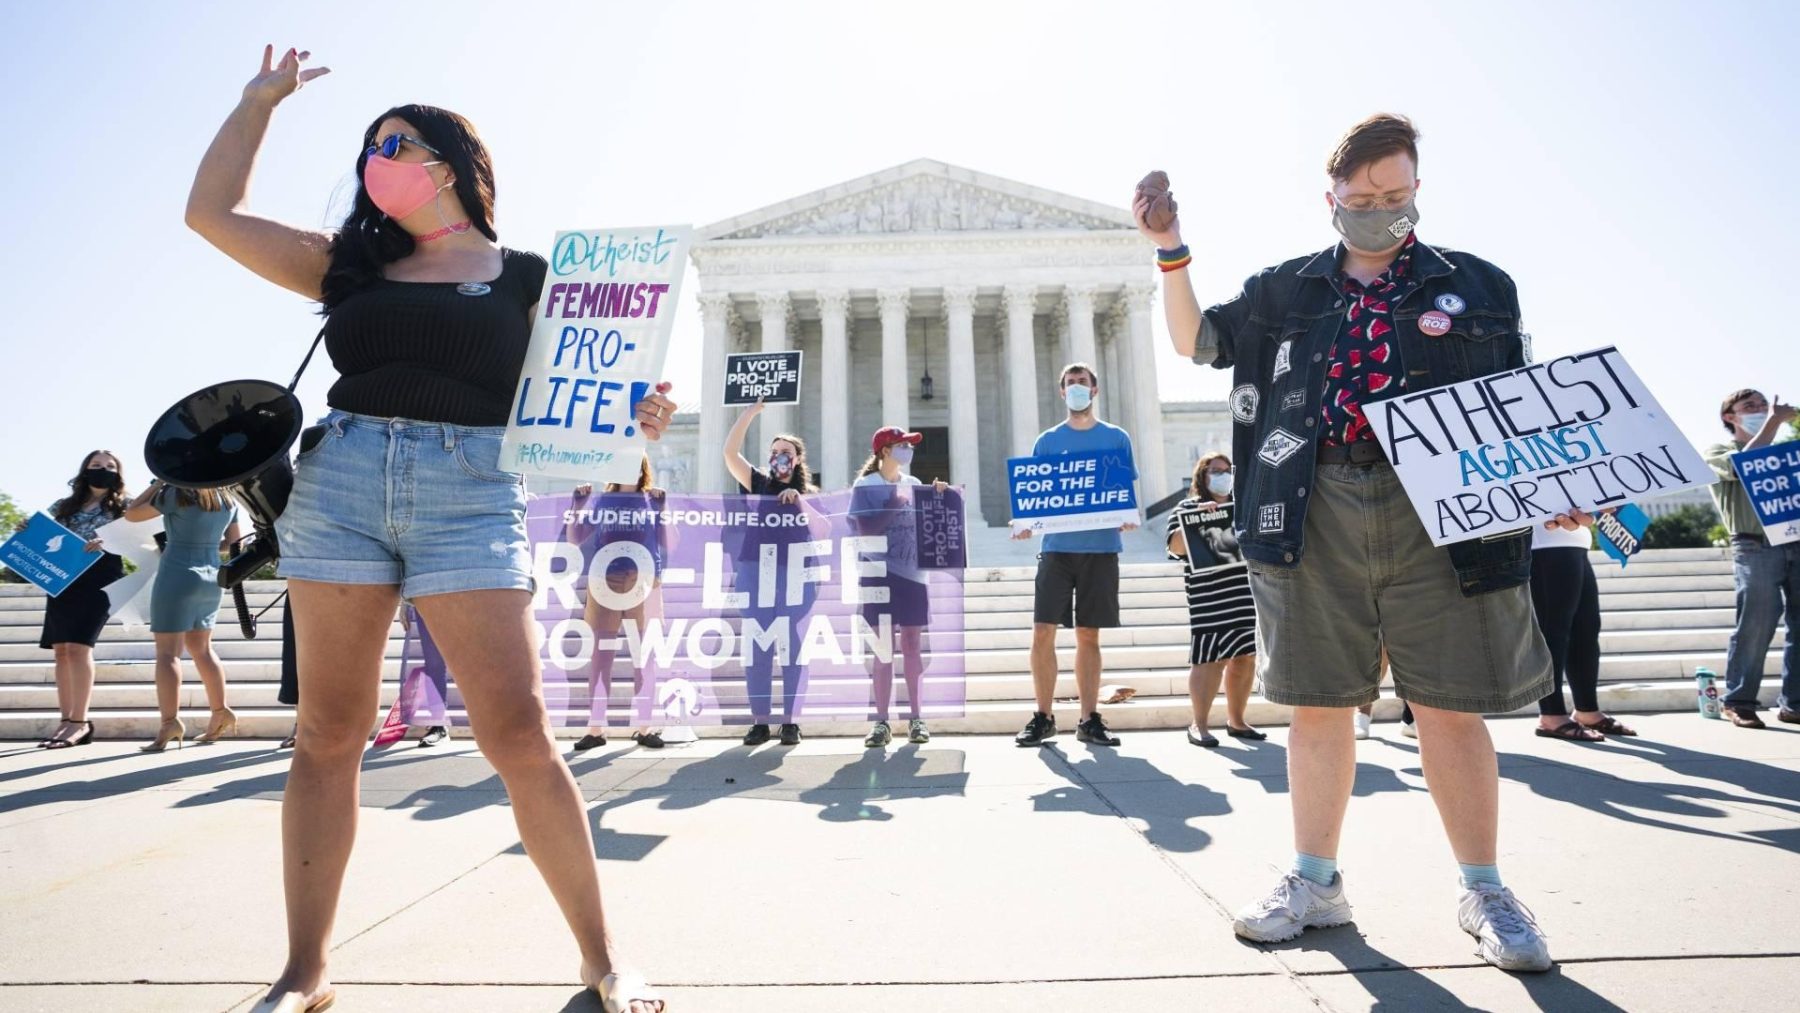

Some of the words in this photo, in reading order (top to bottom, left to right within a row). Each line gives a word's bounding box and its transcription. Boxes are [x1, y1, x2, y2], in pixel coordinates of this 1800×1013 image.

[545, 282, 670, 319] FEMINIST
[1421, 319, 1449, 330] ROE
[553, 325, 636, 374] PRO-
[727, 370, 797, 385] PRO-LIFE
[736, 361, 742, 373] I
[747, 359, 788, 372] VOTE
[740, 383, 780, 397] FIRST
[516, 377, 650, 437] LIFE!
[1384, 345, 1641, 466] ATHEIST
[515, 443, 614, 471] #Rehumanize
[1457, 420, 1611, 487] AGAINST
[1013, 459, 1097, 478] PRO-LIFE
[1015, 479, 1054, 494] FOR
[1059, 475, 1096, 490] THE
[1434, 444, 1692, 539] ABORTION
[1751, 475, 1790, 496] FOR
[1017, 493, 1085, 511] WHOLE
[1090, 489, 1130, 505] LIFE
[1262, 506, 1280, 515] END
[562, 509, 810, 528] STUDENTSFORLIFE.ORG
[922, 499, 935, 545] VOTE
[933, 491, 948, 567] PRO-LIFE
[946, 507, 960, 550] FIRST
[1184, 514, 1200, 525] Life
[1200, 509, 1229, 522] Counts
[1262, 513, 1280, 521] THE
[1596, 512, 1638, 556] PROFITS
[533, 535, 892, 611] RO-LIFE
